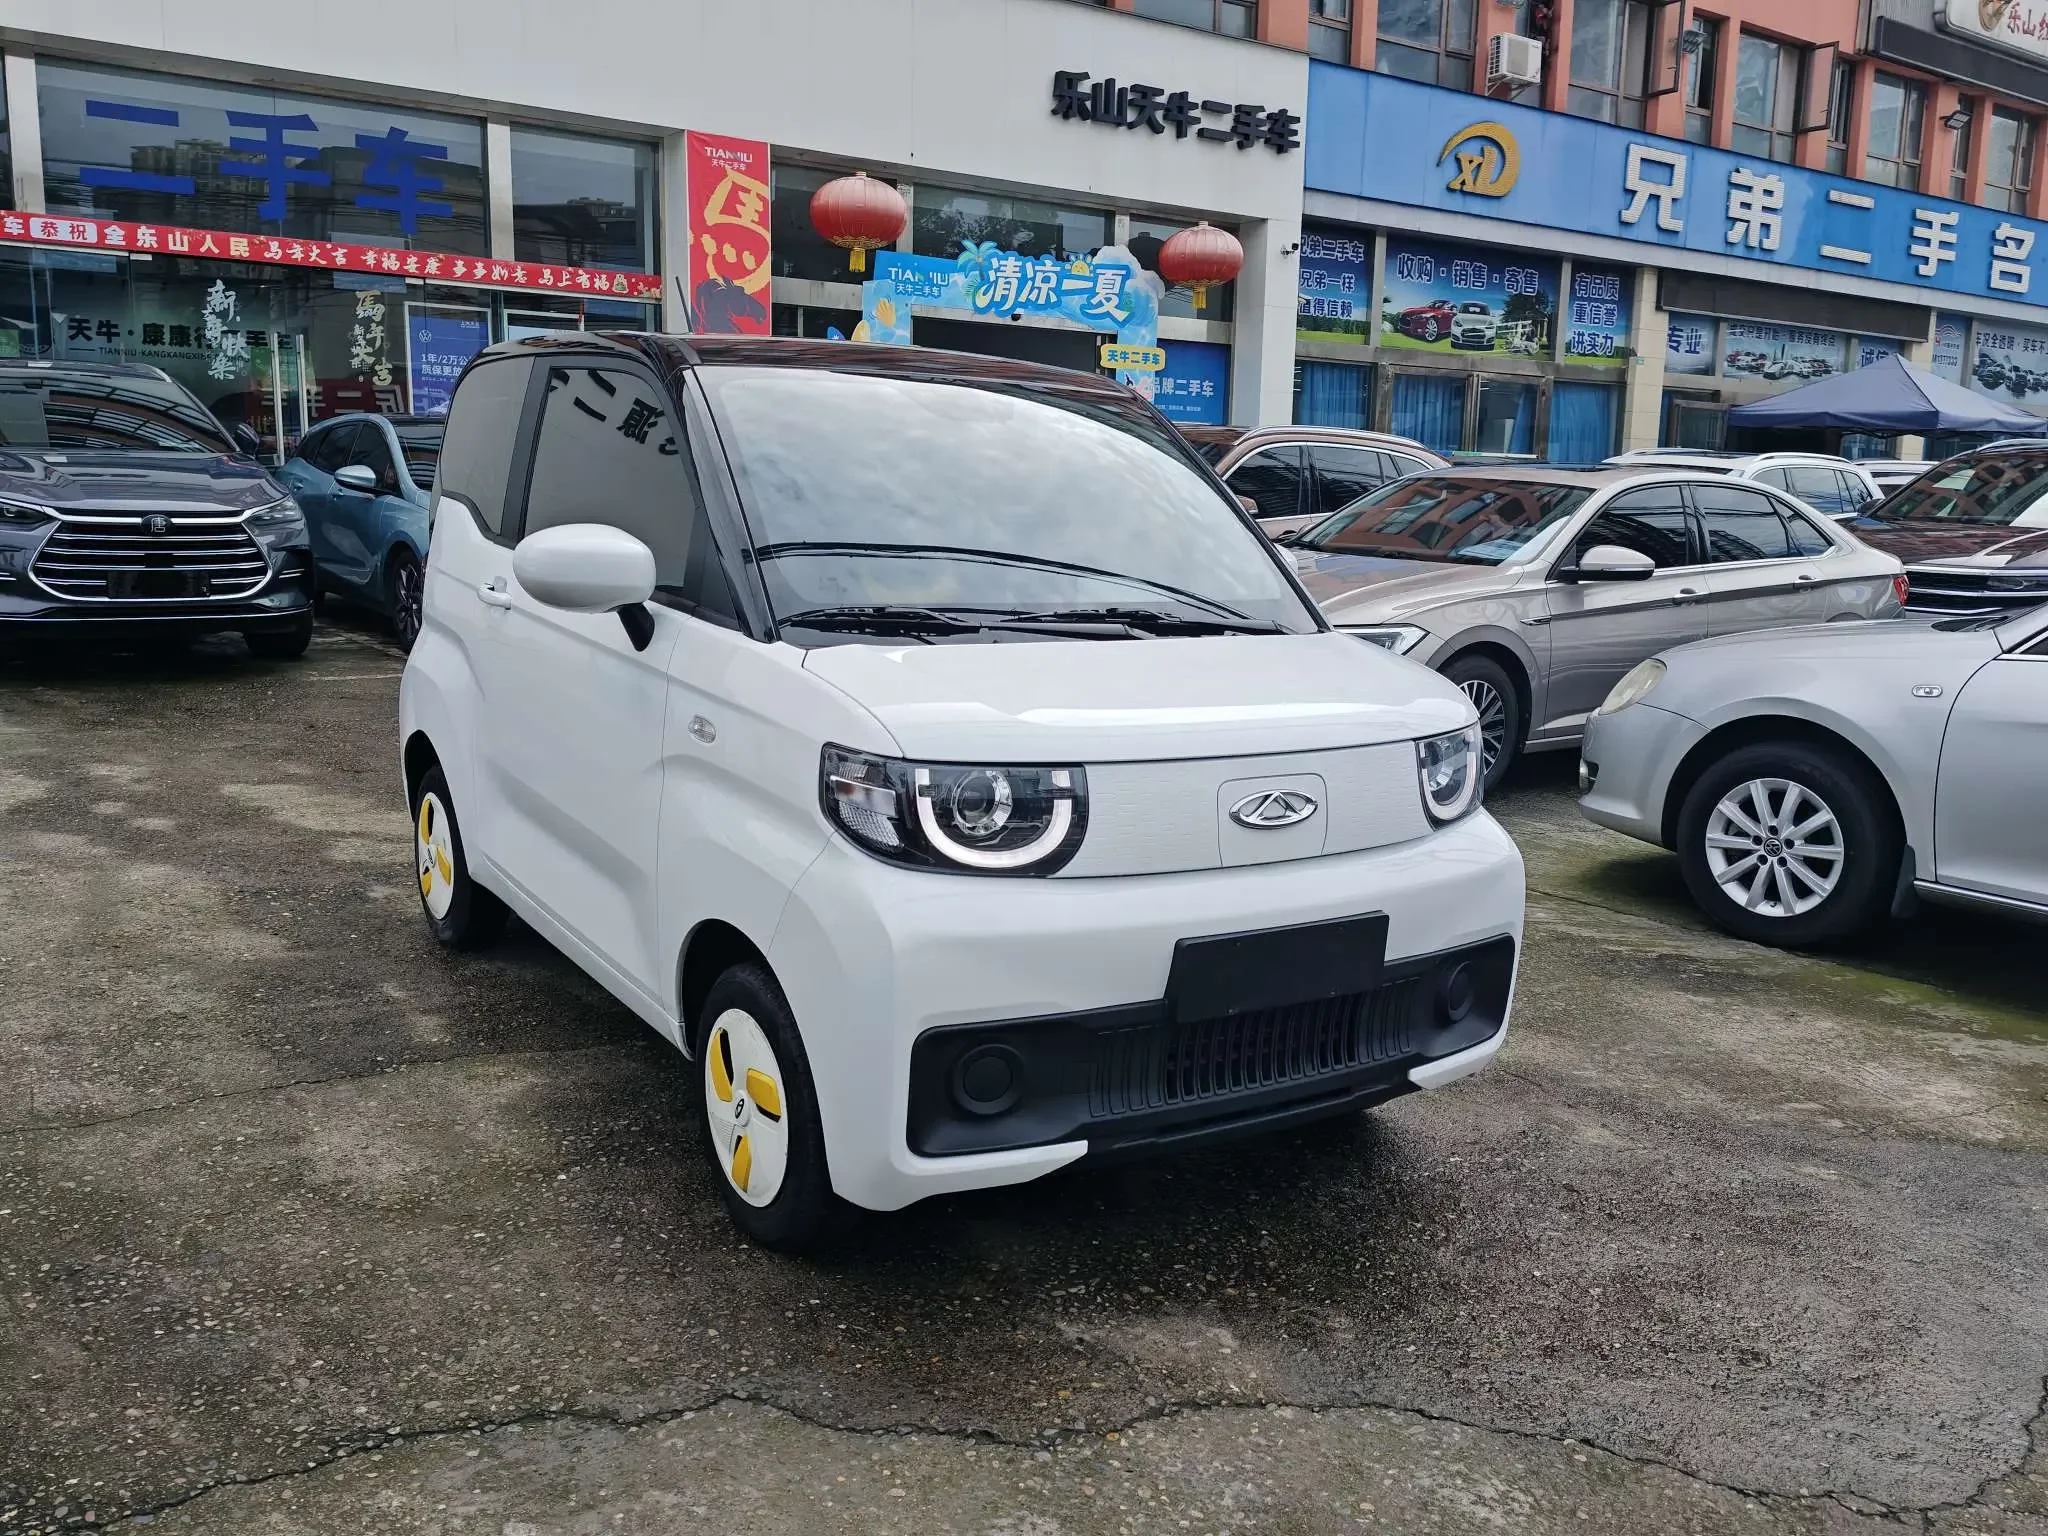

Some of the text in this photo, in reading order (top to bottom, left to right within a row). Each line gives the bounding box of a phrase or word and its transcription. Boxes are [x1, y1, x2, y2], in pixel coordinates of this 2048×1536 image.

[1051, 70, 1301, 154] 乐山天牛二手车
[79, 99, 453, 235] 二手车
[711, 158, 747, 171] 天牛二手车
[4, 216, 25, 236] 车
[40, 220, 88, 240] 恭祝
[1621, 143, 2036, 294] 兄弟二手名
[896, 284, 942, 299] 天牛二手车
[975, 255, 1132, 323] 清凉一夏
[1300, 269, 1356, 294] 兄弟一样
[1575, 272, 1620, 301] 有品质
[1573, 301, 1618, 328] 重信誉
[1571, 330, 1615, 357] 讲实力
[1667, 324, 1703, 355] 专业
[1107, 349, 1161, 366] 天牛二手车
